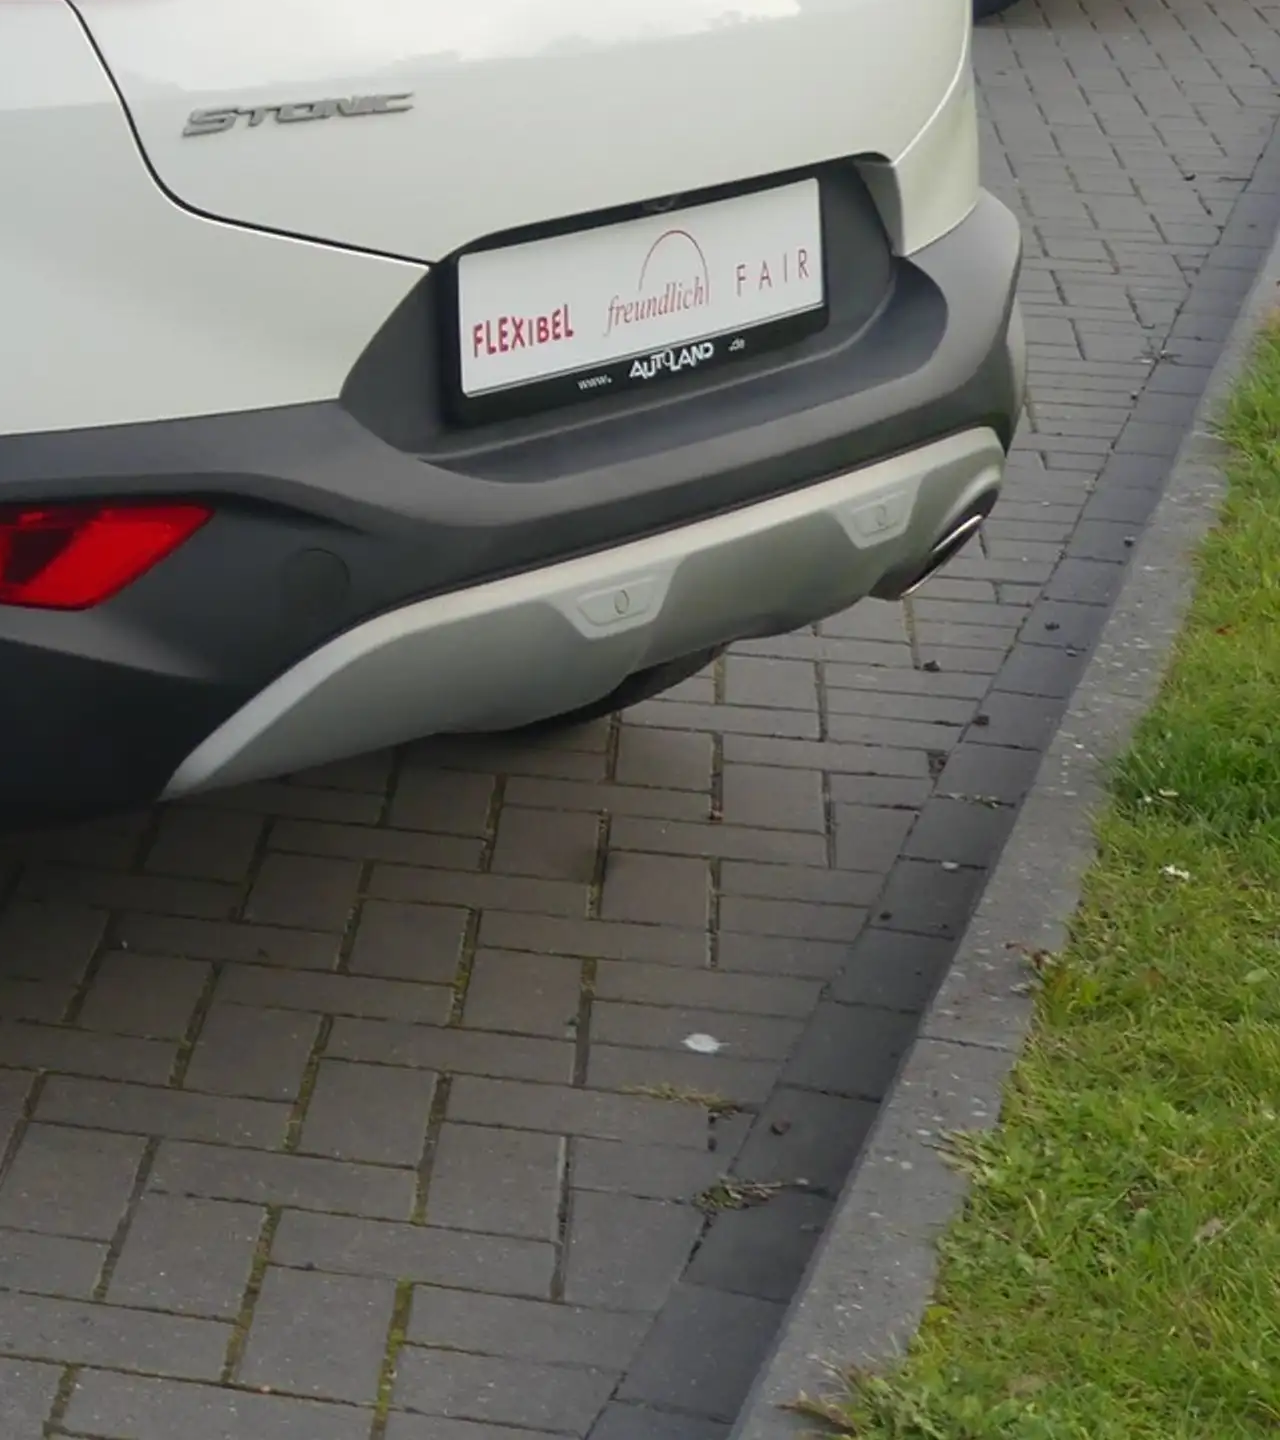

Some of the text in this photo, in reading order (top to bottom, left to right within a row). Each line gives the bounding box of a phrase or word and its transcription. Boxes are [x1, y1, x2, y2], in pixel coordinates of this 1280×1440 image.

[182, 92, 414, 137] STONIC
[472, 249, 809, 358] FLEXIBEL freundlich FAIR
[629, 341, 715, 379] AUTOLAND
